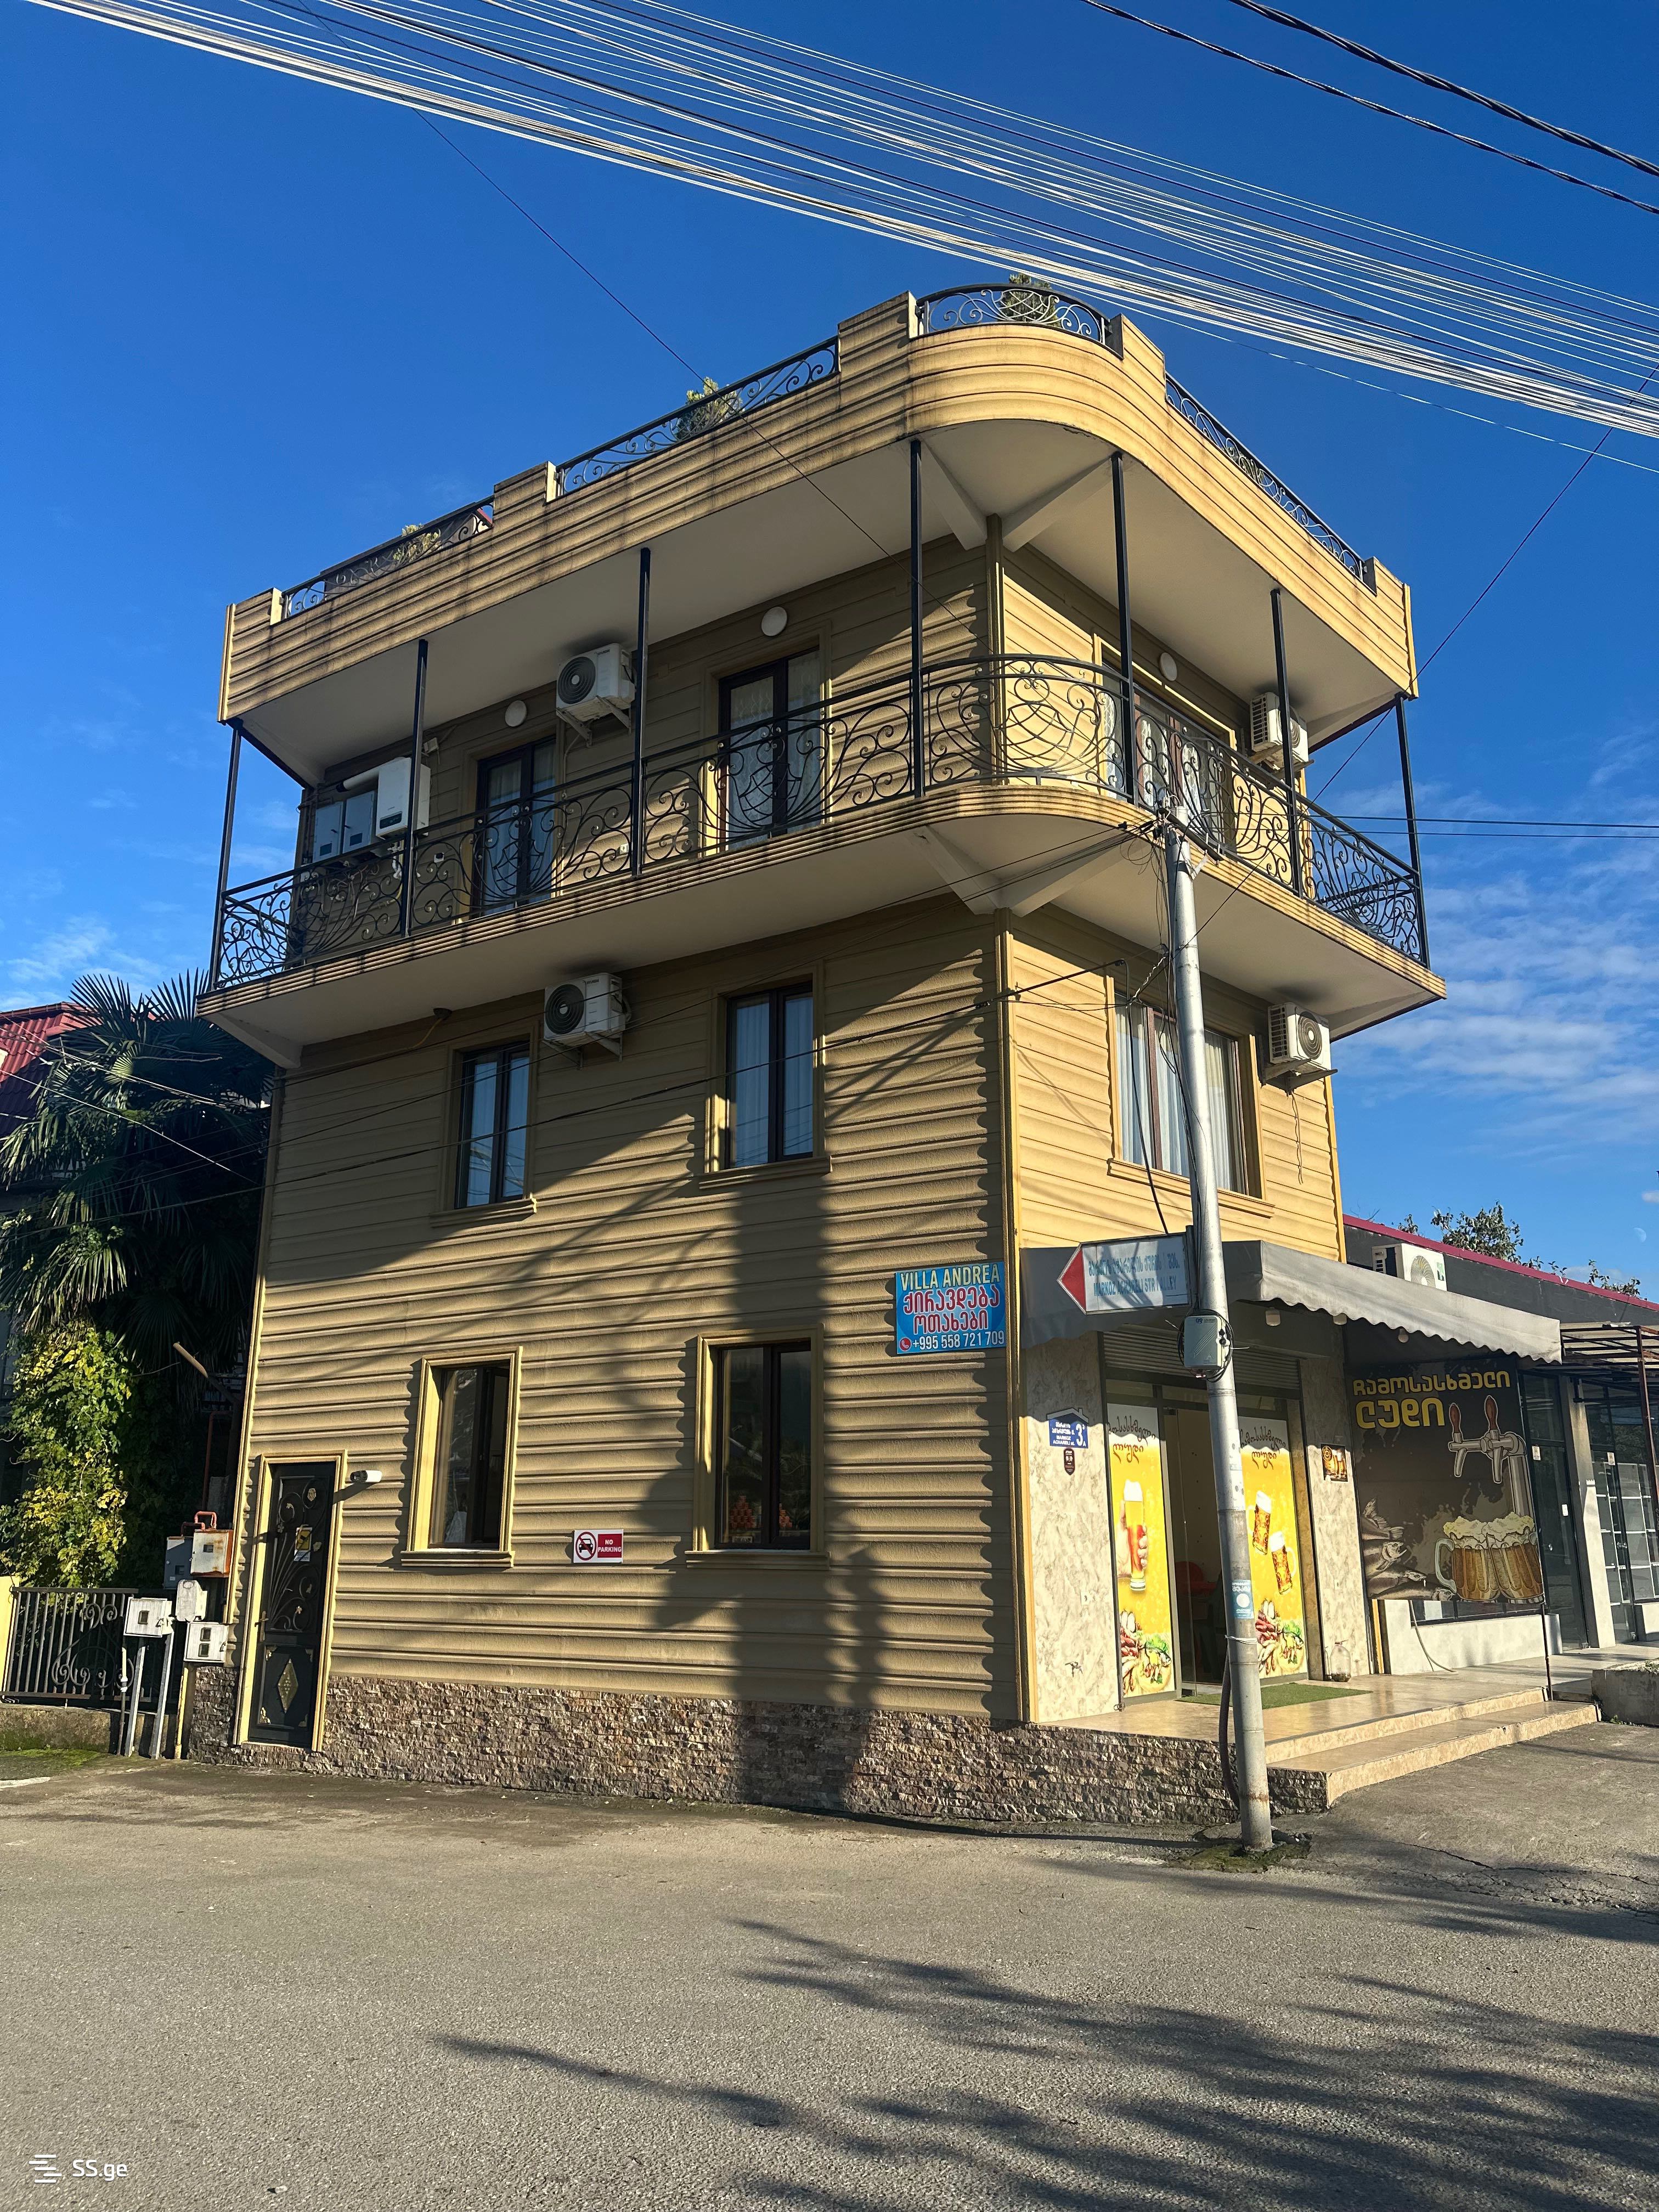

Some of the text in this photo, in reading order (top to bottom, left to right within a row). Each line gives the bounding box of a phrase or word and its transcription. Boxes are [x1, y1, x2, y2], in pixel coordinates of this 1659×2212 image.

[900, 1263, 1001, 1291] VILLA ANDREA
[1093, 1281, 1116, 1296] MARKOZ
[1144, 1277, 1156, 1293] STR
[1160, 1276, 1177, 1291] ALLEY
[903, 1285, 1000, 1314] ქირავდება
[913, 1310, 989, 1335] ოთახები
[912, 1330, 1005, 1350] +995 558 721 709
[1353, 1370, 1511, 1396] ჩამოსასხმელი
[1355, 1397, 1446, 1430] ლუდი
[1075, 1423, 1084, 1446] 3
[1113, 1443, 1144, 1464] ლუდი
[1251, 1451, 1277, 1470] ლუდი
